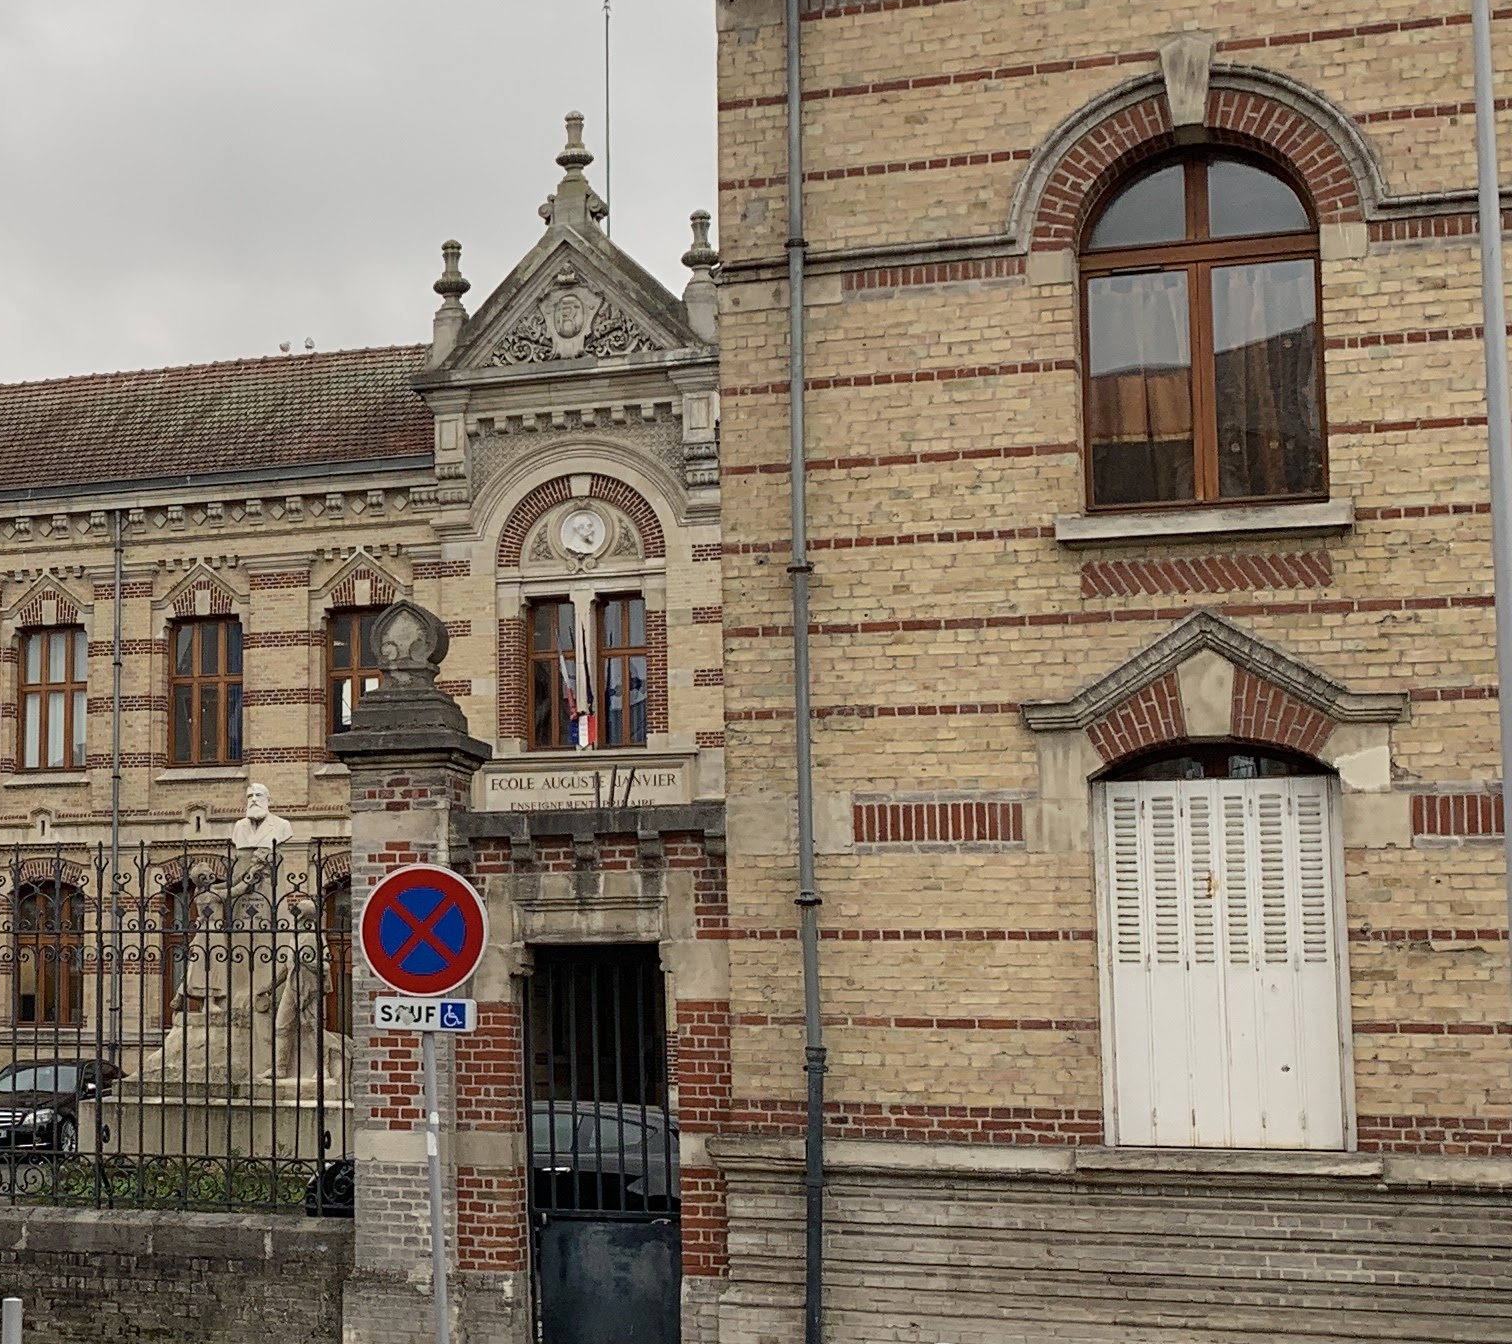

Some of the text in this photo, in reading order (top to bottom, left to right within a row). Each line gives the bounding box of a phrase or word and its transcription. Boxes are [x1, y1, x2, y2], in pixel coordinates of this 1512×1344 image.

[491, 773, 677, 791] ECOLE AUGUSTE JANVIER
[510, 798, 656, 811] ENSEIGNEMENT PRIAIRE
